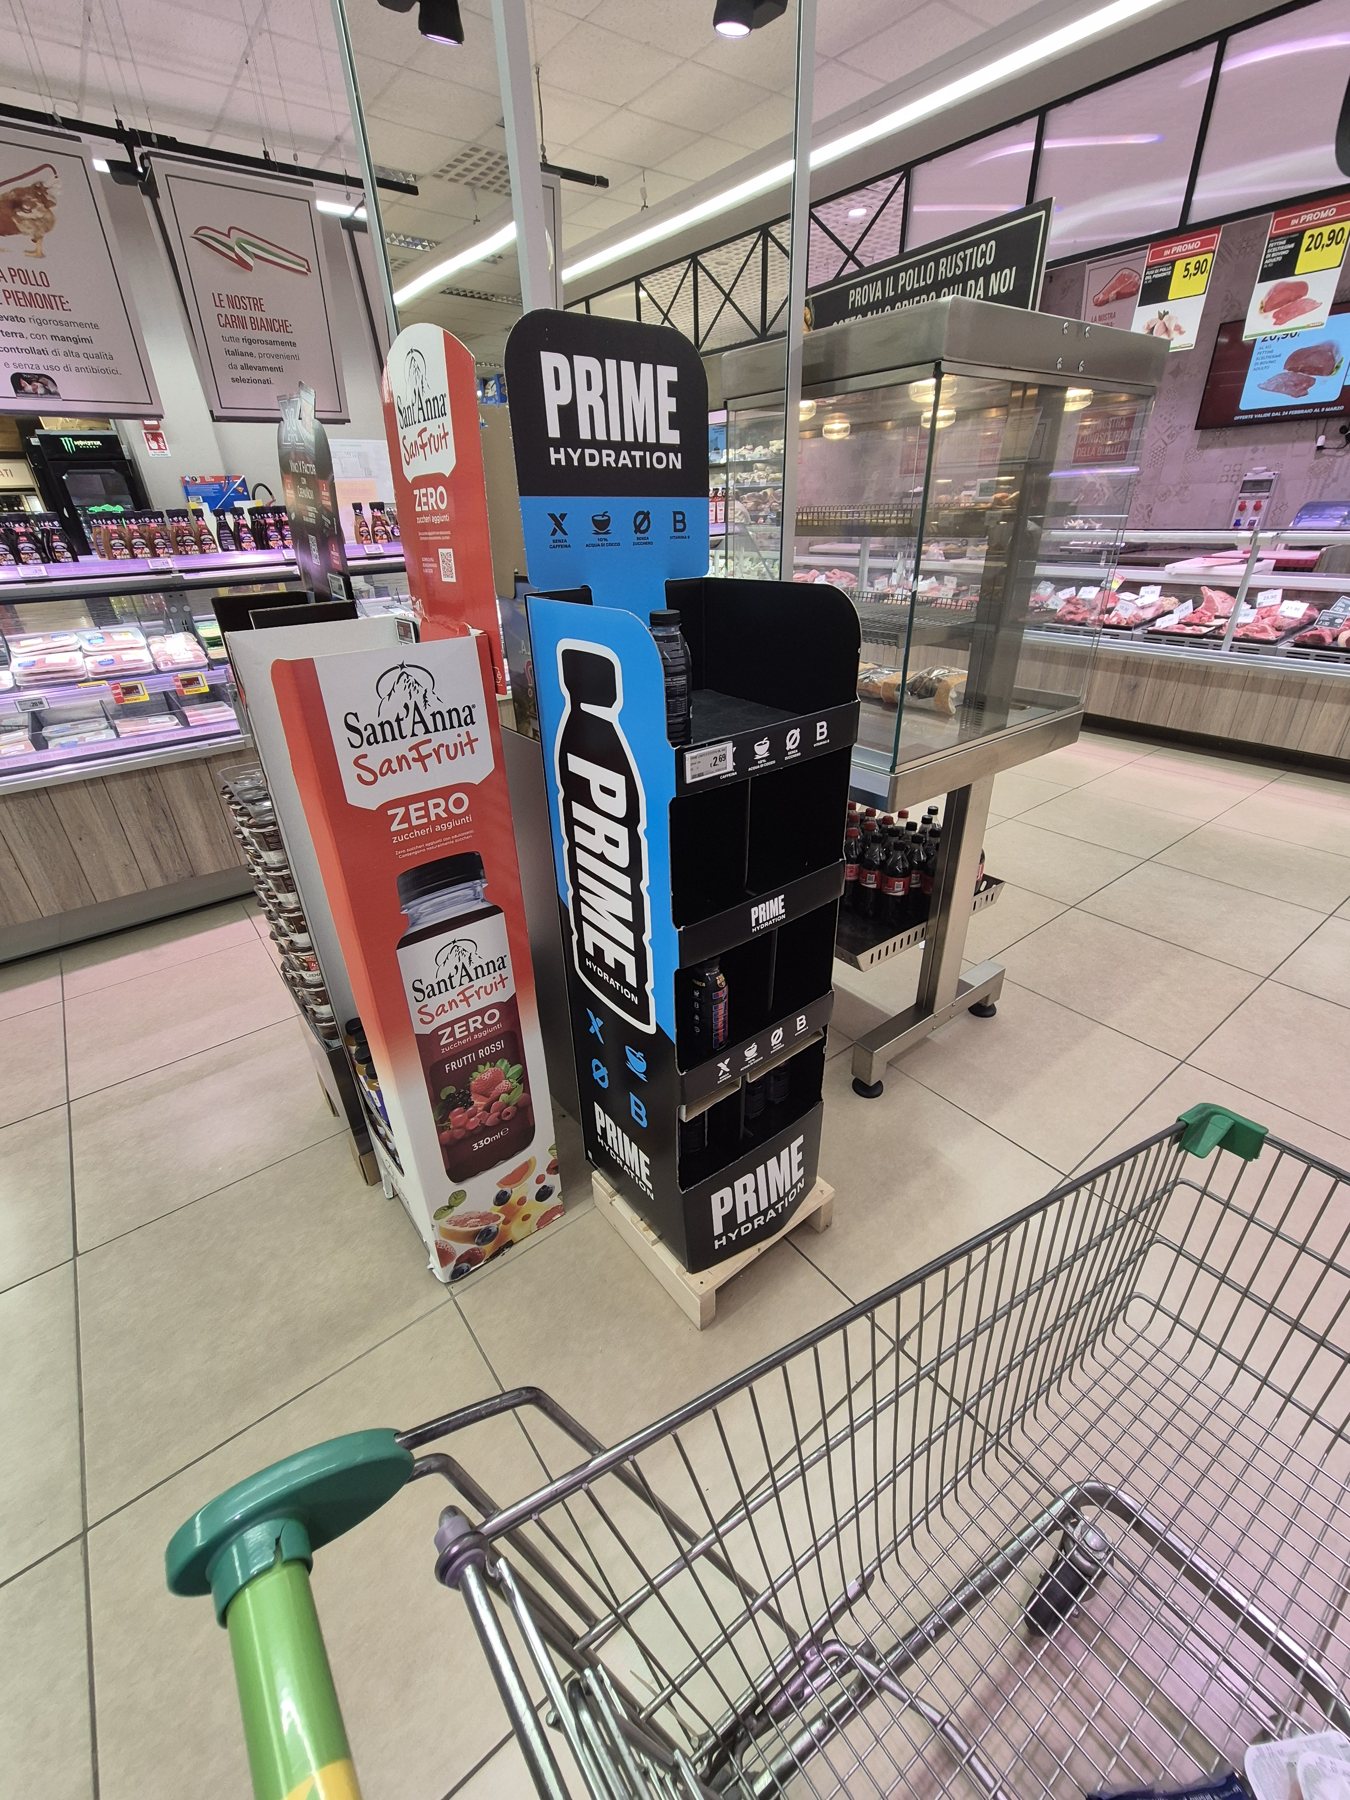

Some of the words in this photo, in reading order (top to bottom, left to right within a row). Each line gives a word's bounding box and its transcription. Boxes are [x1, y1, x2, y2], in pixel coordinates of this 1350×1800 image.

[1300, 208, 1336, 224] PROMO
[1171, 241, 1200, 254] PROMO
[8, 267, 50, 288] POLLO
[849, 280, 882, 309] PROVA
[885, 276, 894, 298] IL
[898, 262, 934, 294] POLLO
[938, 240, 996, 280] RUSTICO
[966, 276, 984, 300] DA
[988, 266, 1016, 297] NOI
[2, 289, 72, 312] PIEMONTE:
[212, 292, 225, 308] LE
[226, 294, 266, 312] NOSTRE
[29, 315, 100, 330] rigorosamente
[216, 313, 248, 330] CARNI
[250, 316, 293, 334] BIANCHE:
[0, 330, 28, 340] terra,
[30, 332, 48, 340] con
[50, 334, 94, 344] mangimi
[222, 335, 240, 343] tutte
[242, 336, 296, 347] rigorosamente
[0, 346, 50, 356] controllati
[52, 348, 60, 357] di
[64, 350, 80, 358] alta
[83, 351, 114, 361] qualità
[224, 348, 256, 358] italiane,
[258, 352, 300, 360] provenienti
[228, 362, 238, 370] da
[240, 363, 284, 372] allevamenti
[13, 362, 40, 370] senza
[43, 364, 60, 372] uso
[64, 364, 72, 372] di
[75, 366, 122, 376] antibiotici.
[231, 376, 273, 384] selezionati.
[540, 350, 681, 446] PRIME
[402, 422, 449, 466] SanFruit
[550, 447, 682, 470] HYDRATION
[413, 485, 447, 512] ZERO
[432, 514, 450, 524] aggiunti
[352, 730, 479, 786] SanFruit
[387, 792, 470, 832] ZERO
[392, 825, 433, 844] zuccheri
[435, 814, 473, 832] aggiunti
[566, 752, 637, 988] PRIME
[751, 894, 785, 927] PRIME
[752, 914, 786, 932] HYDRATION
[585, 957, 639, 1005] HYDRATION
[416, 972, 508, 1025] SanFruit
[438, 1008, 500, 1046] ZERO
[440, 1036, 472, 1054] zuccheri
[473, 1022, 502, 1041] aggiunti
[445, 1052, 476, 1074] FRUTTI
[479, 1039, 505, 1060] ROSSI
[594, 1101, 653, 1190] PRIME
[597, 1136, 654, 1200] HYDRATION
[710, 1134, 804, 1236] PRIME
[714, 1178, 804, 1250] HYDRATION
